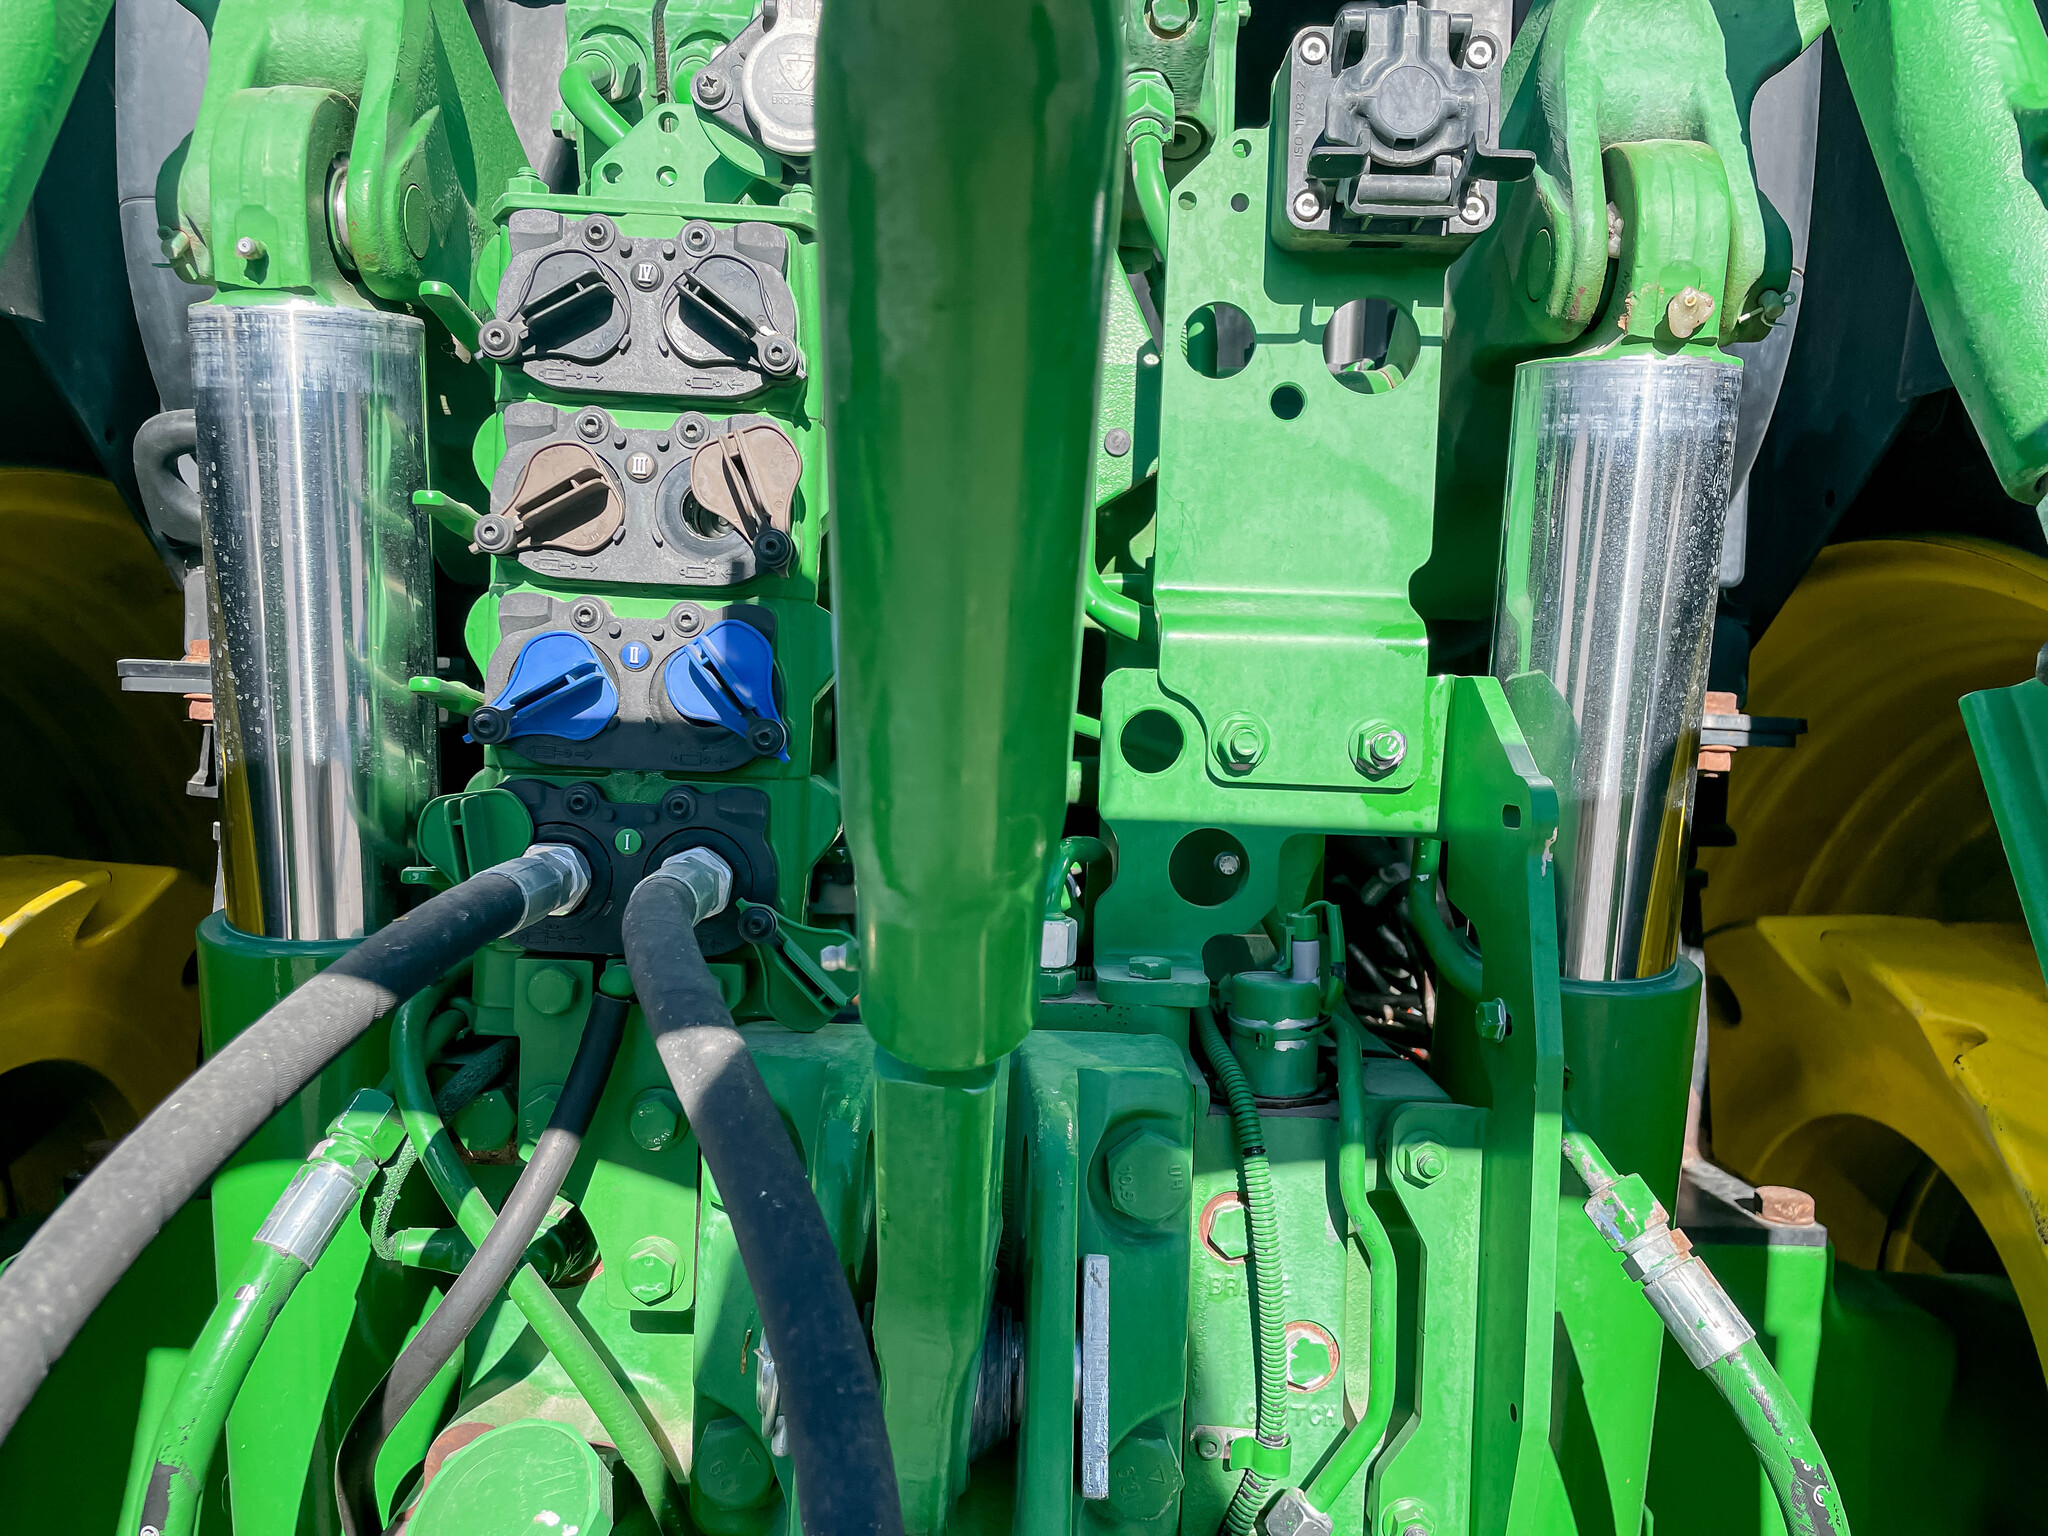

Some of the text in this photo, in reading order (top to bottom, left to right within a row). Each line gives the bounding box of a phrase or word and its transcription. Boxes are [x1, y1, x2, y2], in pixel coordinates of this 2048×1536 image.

[1295, 94, 1306, 127] 11783
[1294, 136, 1304, 158] ISO
[637, 263, 654, 285] IV
[632, 456, 648, 476] III
[628, 646, 640, 665] II
[623, 833, 630, 851] I
